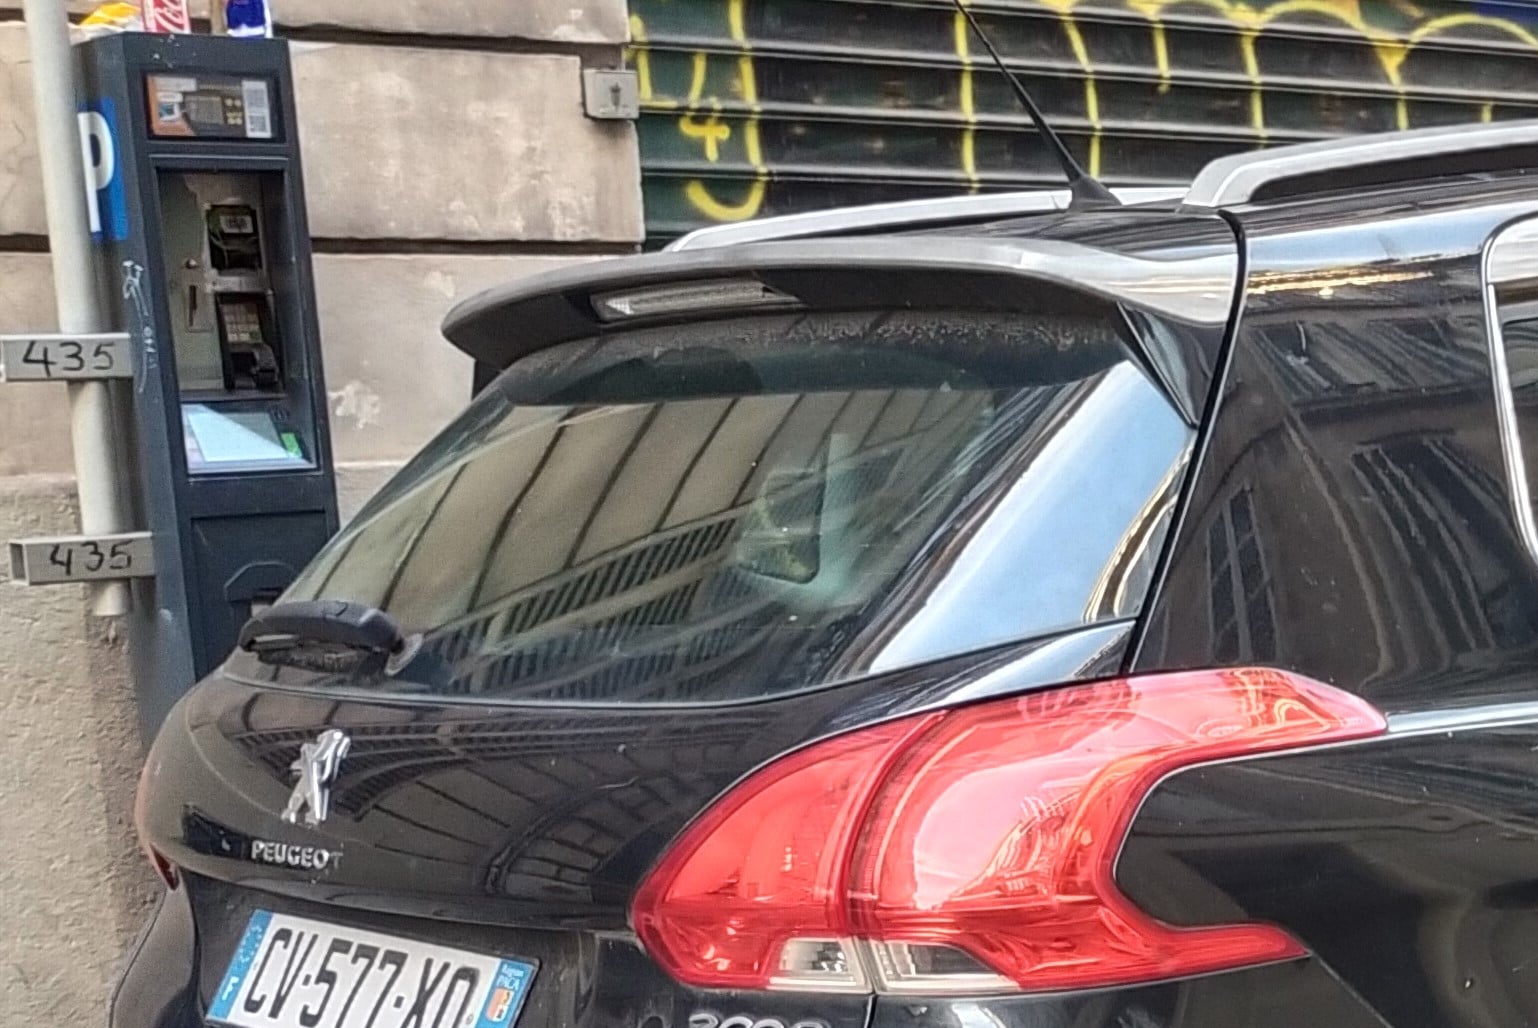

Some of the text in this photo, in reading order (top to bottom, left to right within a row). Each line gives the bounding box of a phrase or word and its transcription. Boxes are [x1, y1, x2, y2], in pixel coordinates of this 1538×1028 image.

[77, 111, 114, 232] P
[22, 340, 115, 377] 435
[50, 540, 133, 576] 435
[251, 840, 344, 869] PEUGEOT
[222, 977, 239, 1001] F
